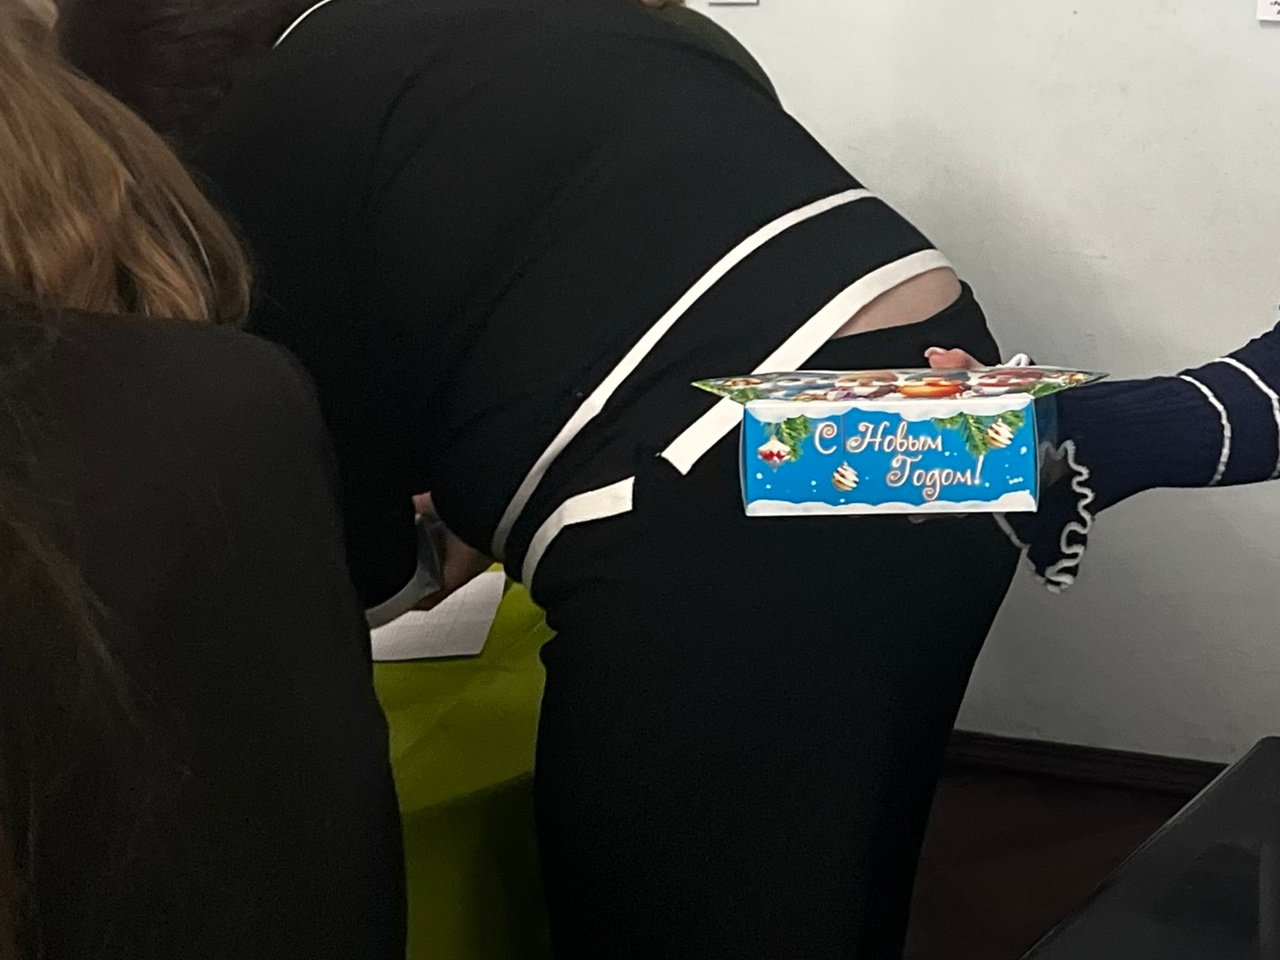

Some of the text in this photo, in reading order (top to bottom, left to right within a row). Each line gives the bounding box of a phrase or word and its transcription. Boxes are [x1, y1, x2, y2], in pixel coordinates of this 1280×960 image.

[814, 420, 943, 455] С Новым
[886, 454, 984, 502] Годом!
